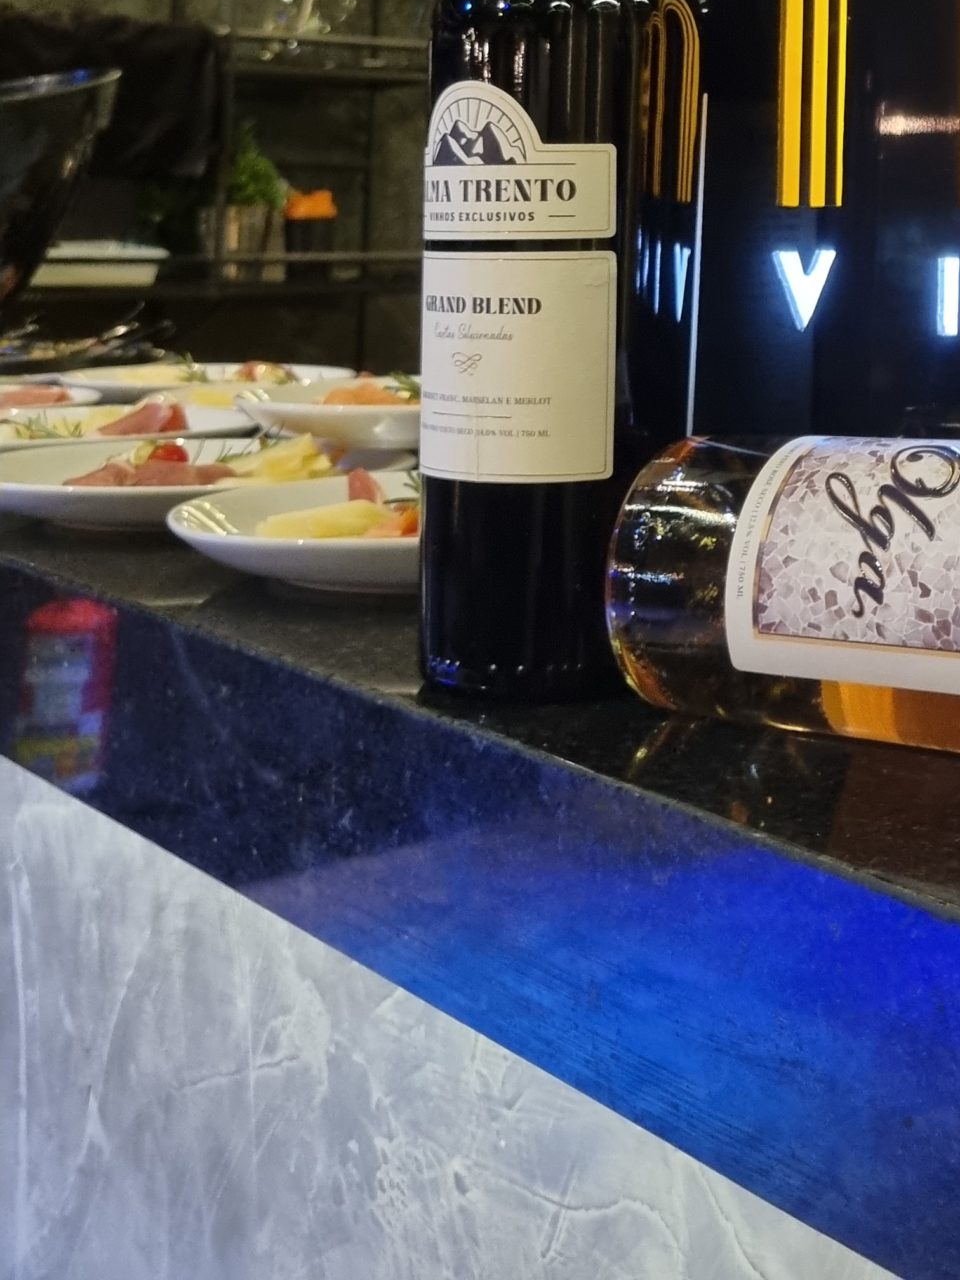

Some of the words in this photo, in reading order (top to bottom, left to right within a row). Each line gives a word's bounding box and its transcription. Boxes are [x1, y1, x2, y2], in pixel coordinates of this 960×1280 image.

[425, 179, 451, 202] LMA
[459, 178, 577, 202] TRENTO
[459, 211, 535, 223] EXCLUSIVOS
[426, 295, 466, 314] GRAND
[472, 297, 542, 315] BLEND
[514, 397, 552, 405] MERLOT
[521, 429, 536, 437] 750
[538, 429, 551, 437] ML
[741, 540, 750, 557] VOL
[738, 566, 746, 583] 750
[736, 585, 744, 599] ML
